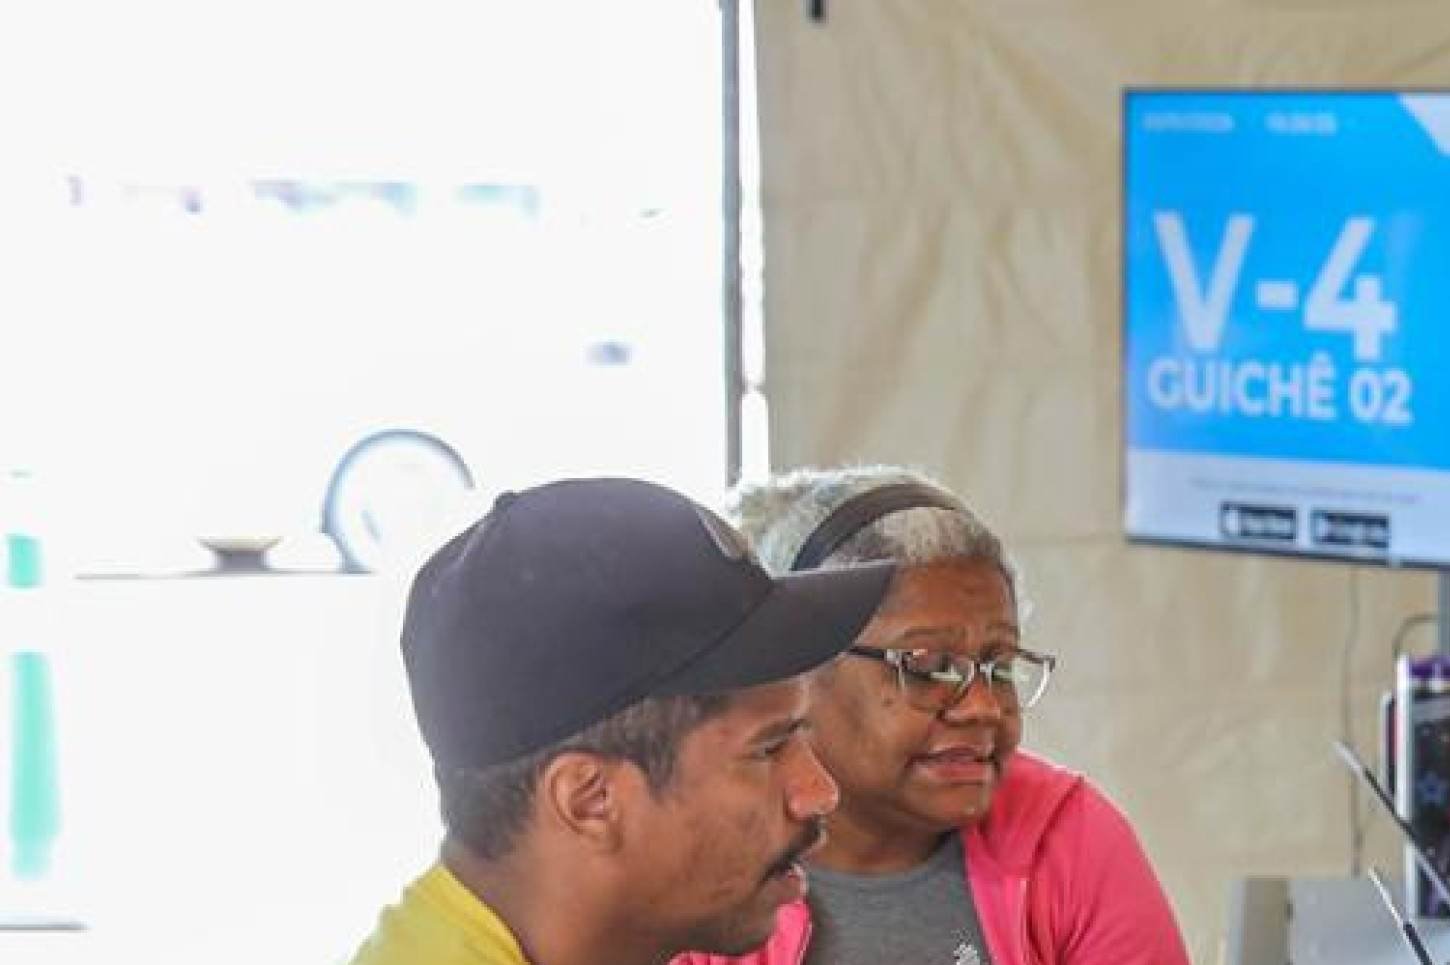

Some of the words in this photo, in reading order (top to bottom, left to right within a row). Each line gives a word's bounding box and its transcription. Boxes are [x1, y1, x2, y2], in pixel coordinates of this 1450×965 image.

[1153, 212, 1398, 361] V-4
[1148, 351, 1337, 421] GUICHÊ
[1350, 367, 1413, 426] 02
